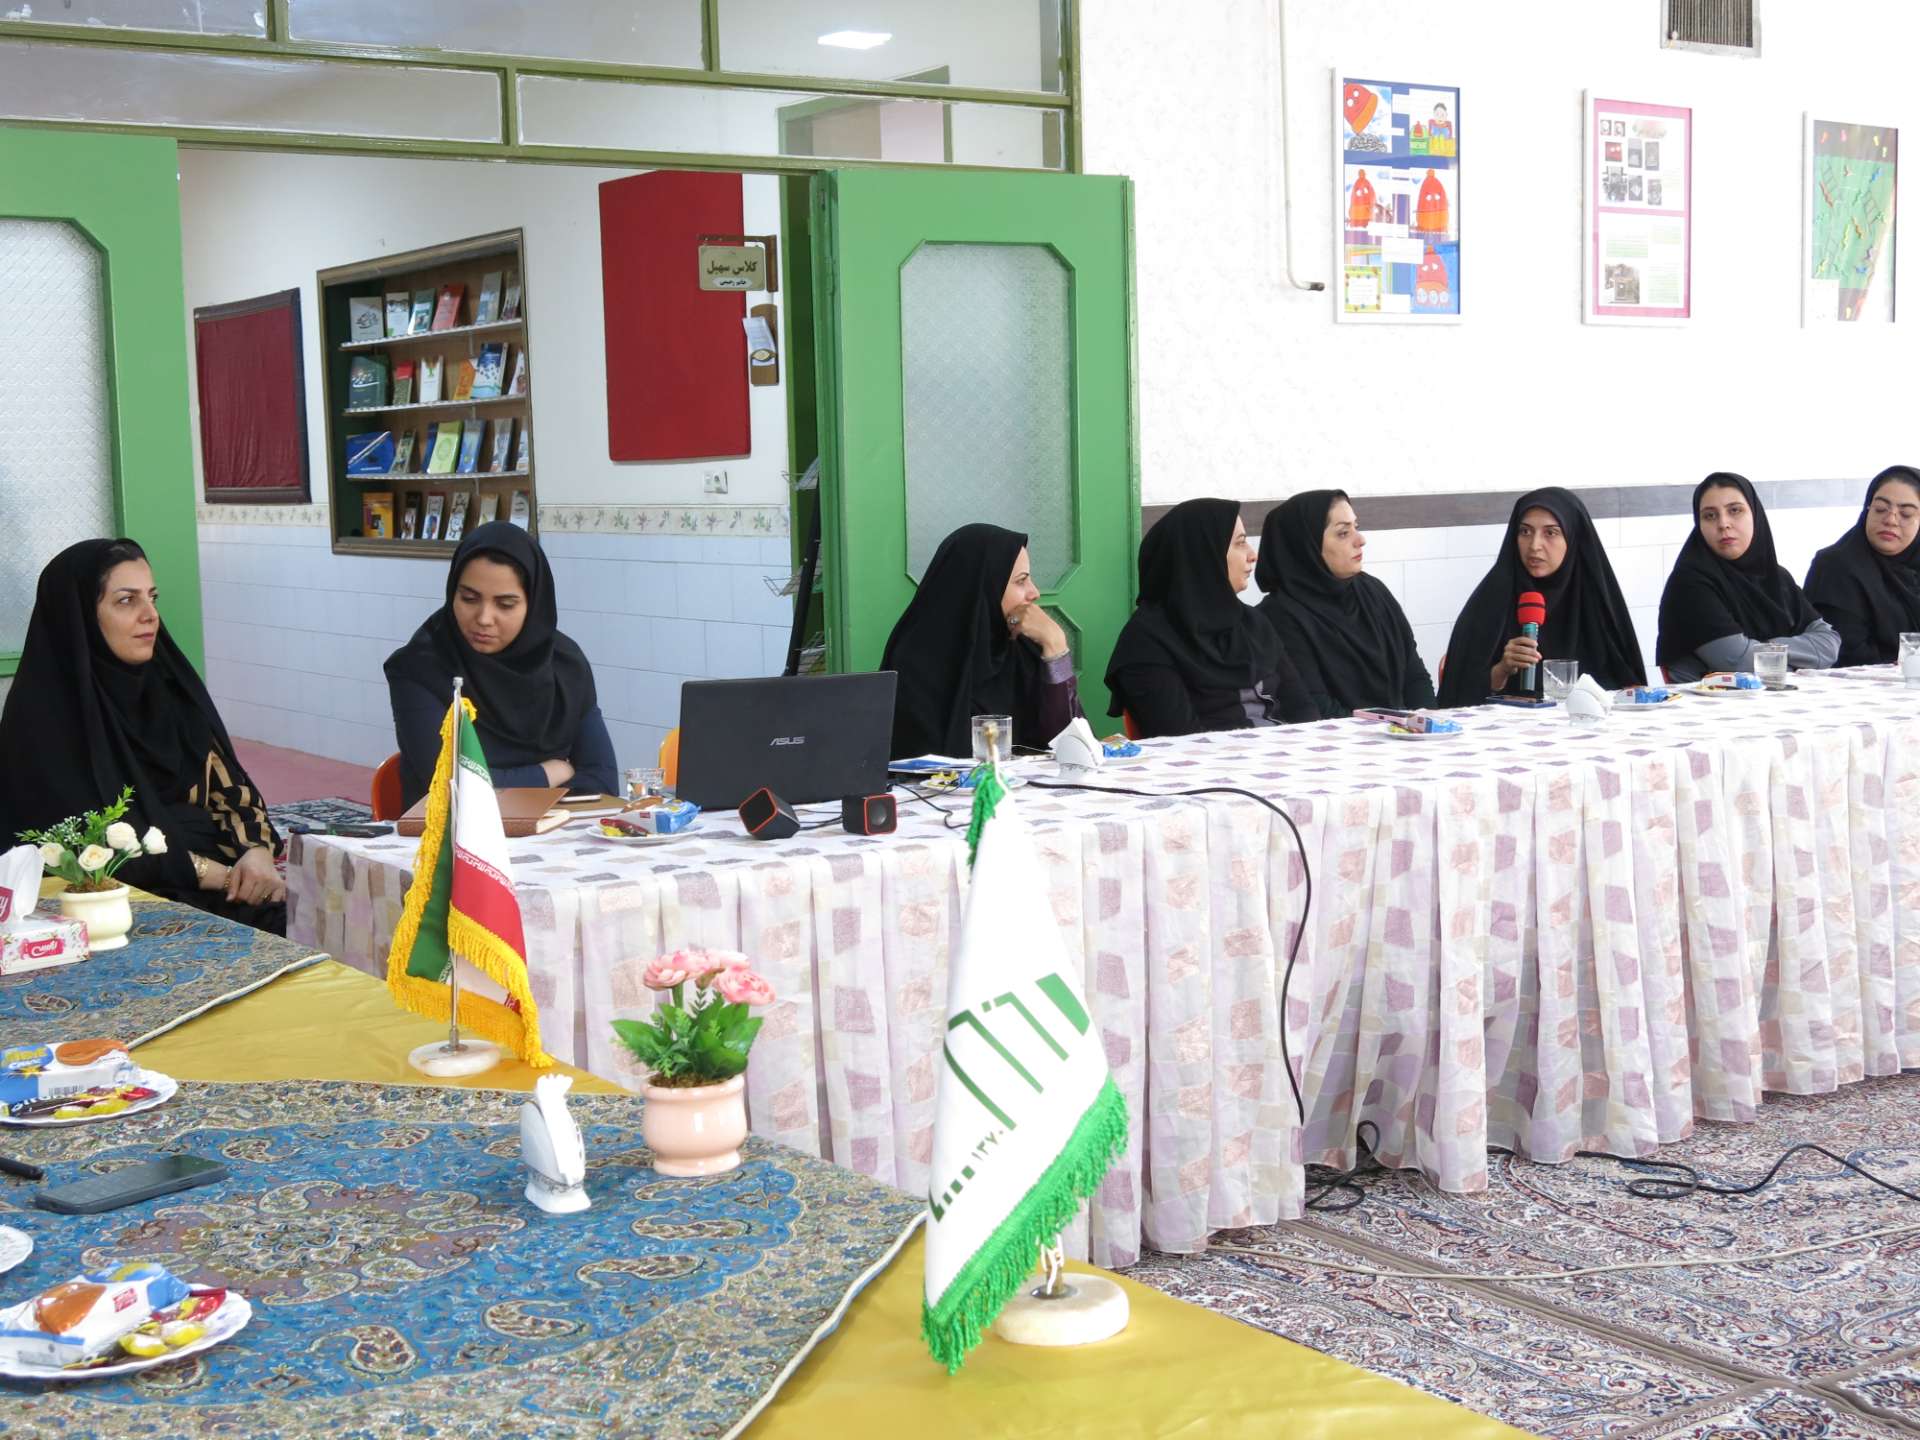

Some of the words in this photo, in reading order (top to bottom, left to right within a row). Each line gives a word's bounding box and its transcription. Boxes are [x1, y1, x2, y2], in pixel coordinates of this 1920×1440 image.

[707, 260, 730, 275] سهیل
[733, 260, 758, 275] کلاس
[770, 736, 805, 746] ASUS
[971, 1130, 1004, 1161] ۱۳۷۰
